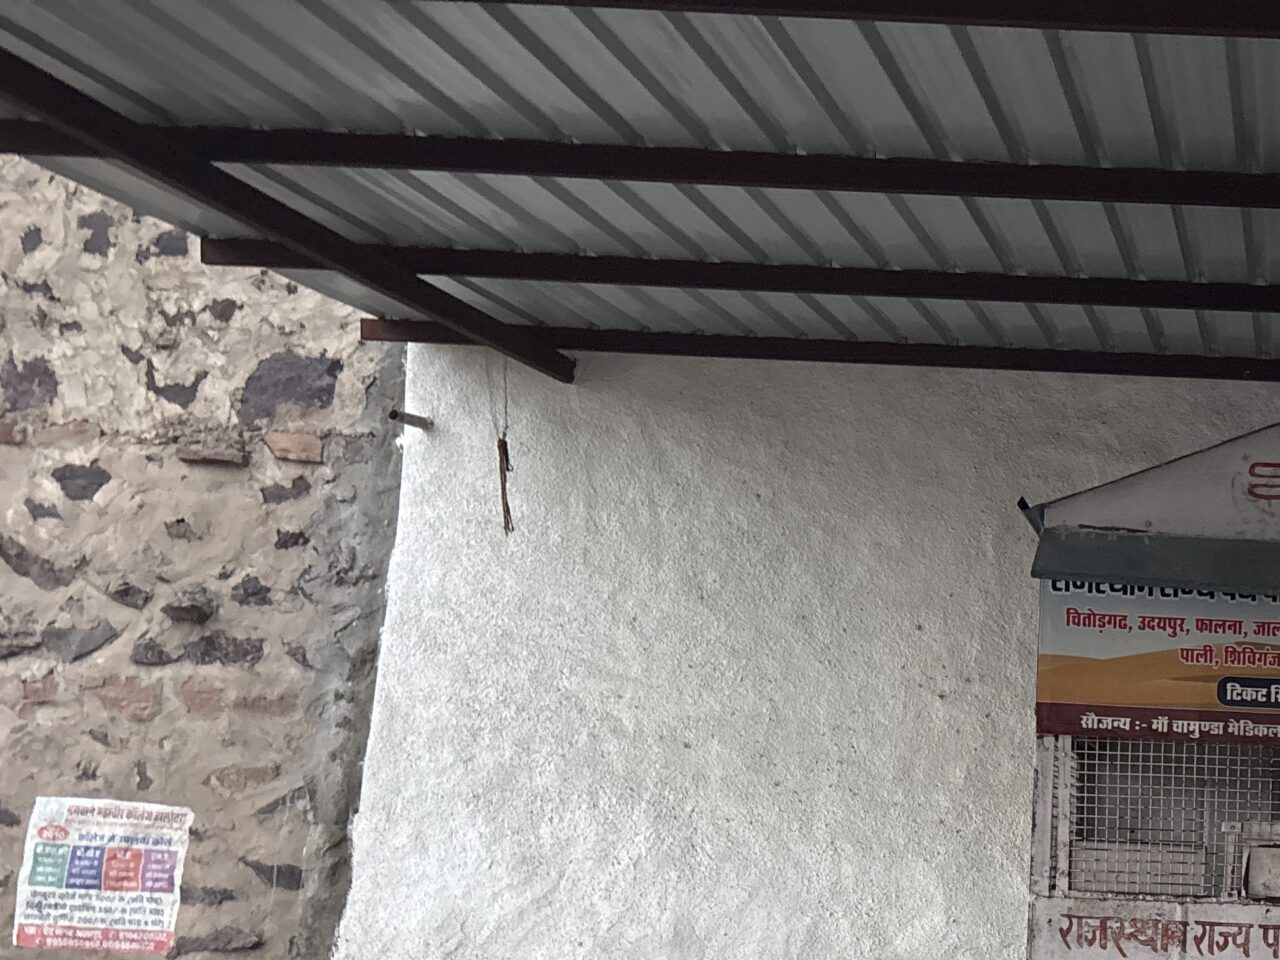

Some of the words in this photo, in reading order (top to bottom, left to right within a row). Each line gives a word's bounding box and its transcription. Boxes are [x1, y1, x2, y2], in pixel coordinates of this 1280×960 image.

[1138, 616, 1189, 637] उदयपुर,
[1196, 618, 1248, 638] फालना,
[1180, 646, 1221, 669] पाली,
[1226, 683, 1267, 702] टिकट
[1080, 712, 1131, 730] सौजन्य
[1172, 719, 1224, 738] चामुण्डा
[1059, 914, 1189, 958] राजस्थान
[1194, 921, 1253, 957] राज्य
